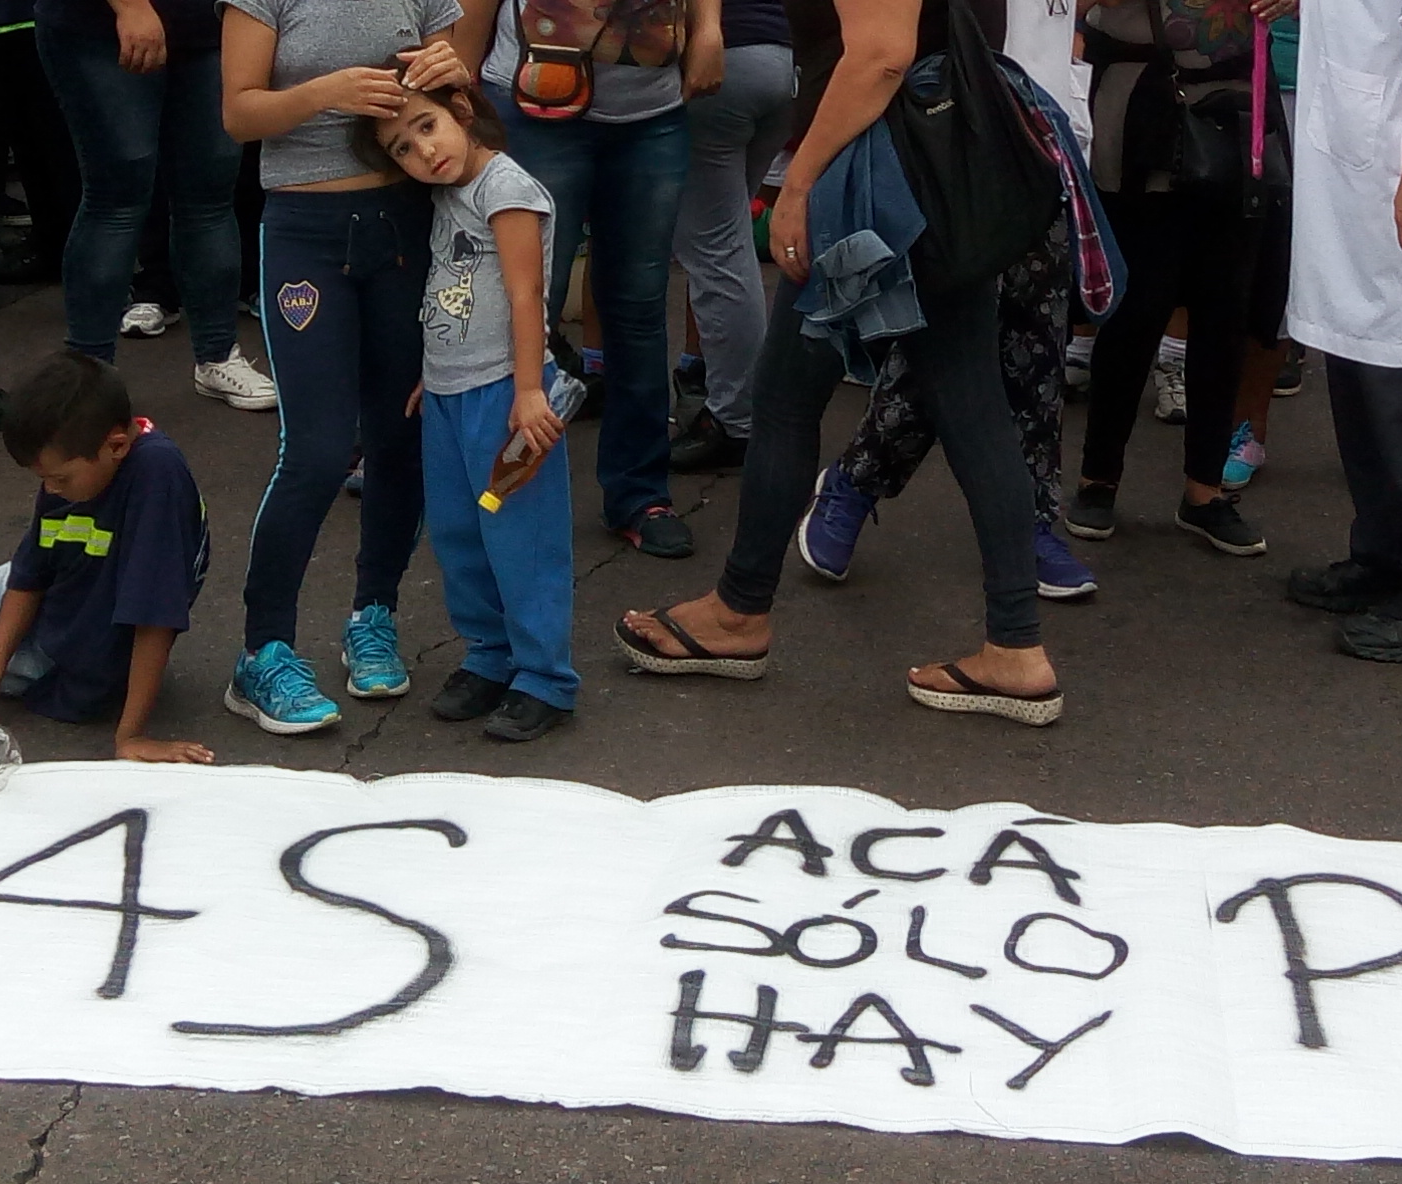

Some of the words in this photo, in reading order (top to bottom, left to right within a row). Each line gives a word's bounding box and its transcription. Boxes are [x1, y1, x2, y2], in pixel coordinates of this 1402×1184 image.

[283, 297, 313, 308] CABJ
[659, 887, 1130, 982] SÓLO
[667, 968, 1114, 1091] HAY
